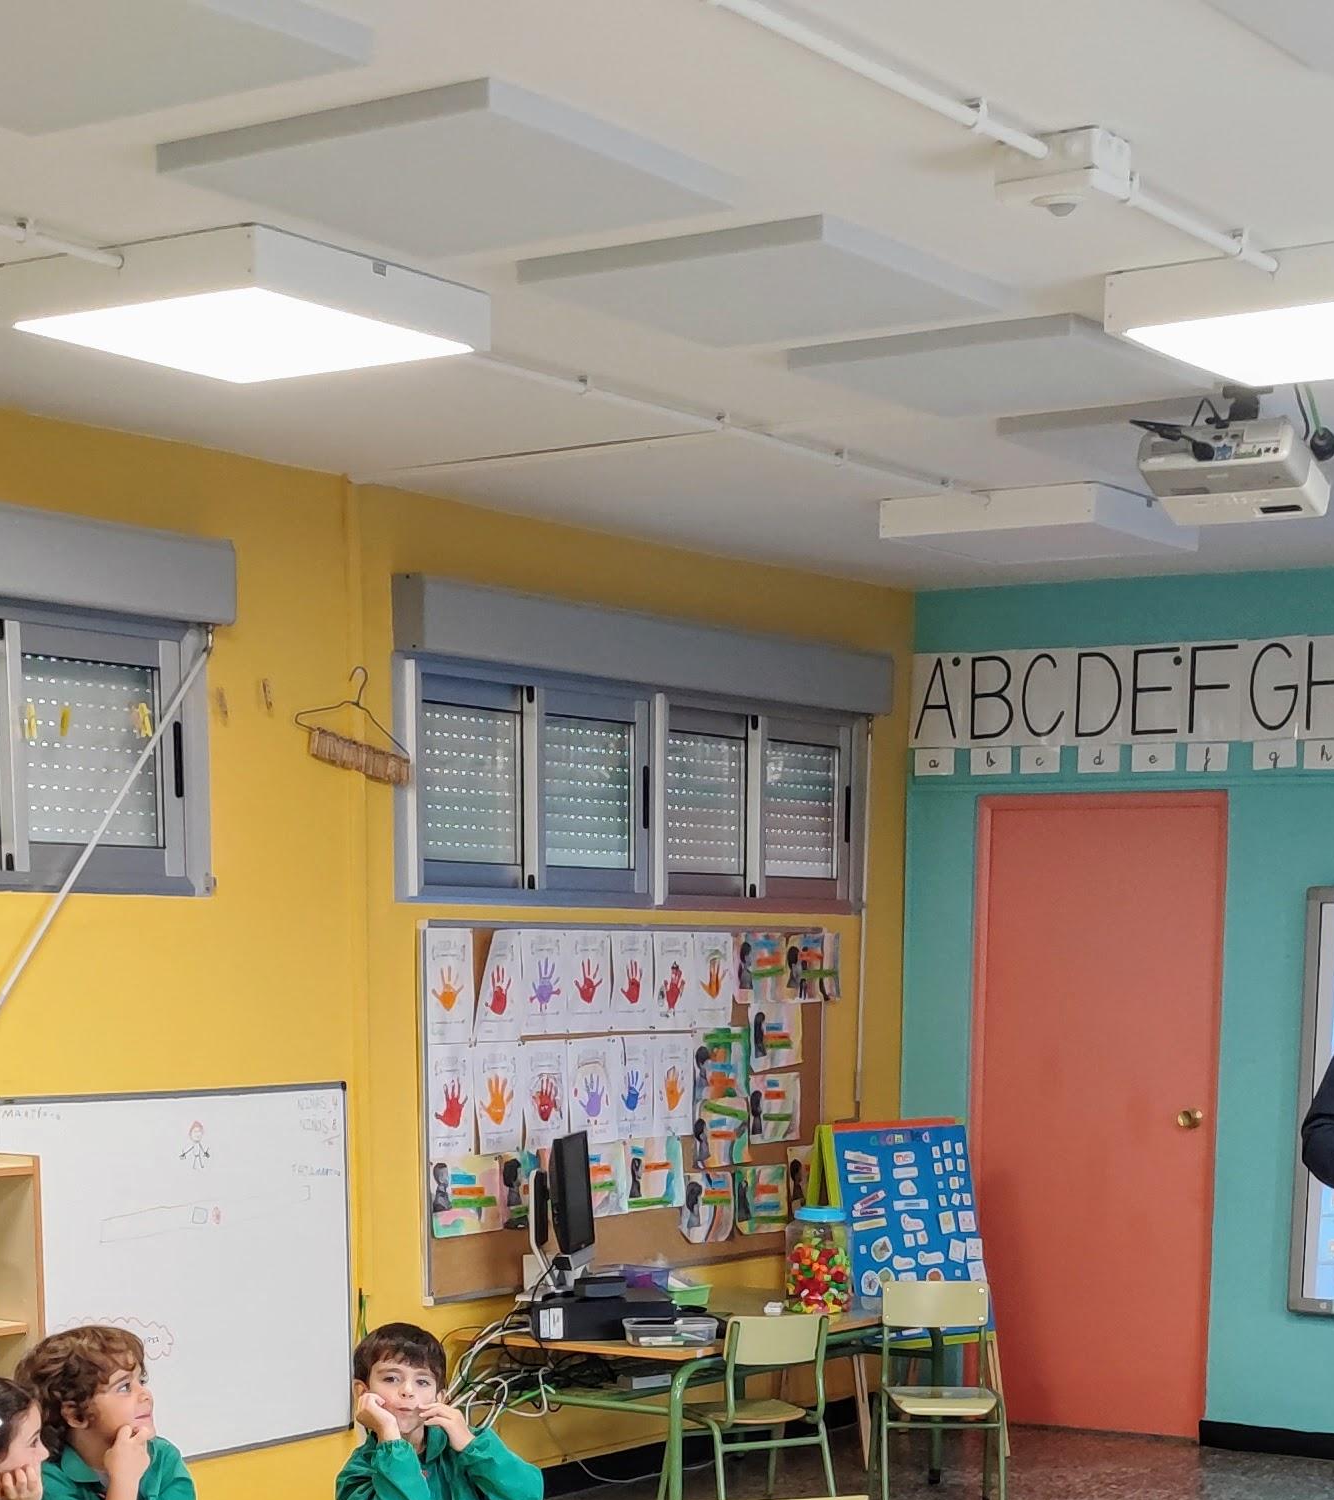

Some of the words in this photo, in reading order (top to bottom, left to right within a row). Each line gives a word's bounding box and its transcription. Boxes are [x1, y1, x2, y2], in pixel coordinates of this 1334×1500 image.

[914, 657, 957, 739] A
[970, 655, 1014, 740] B
[1022, 653, 1065, 738] C
[1075, 651, 1122, 738] D
[1131, 646, 1181, 736] E
[1188, 643, 1239, 734] F
[1250, 642, 1299, 731] G
